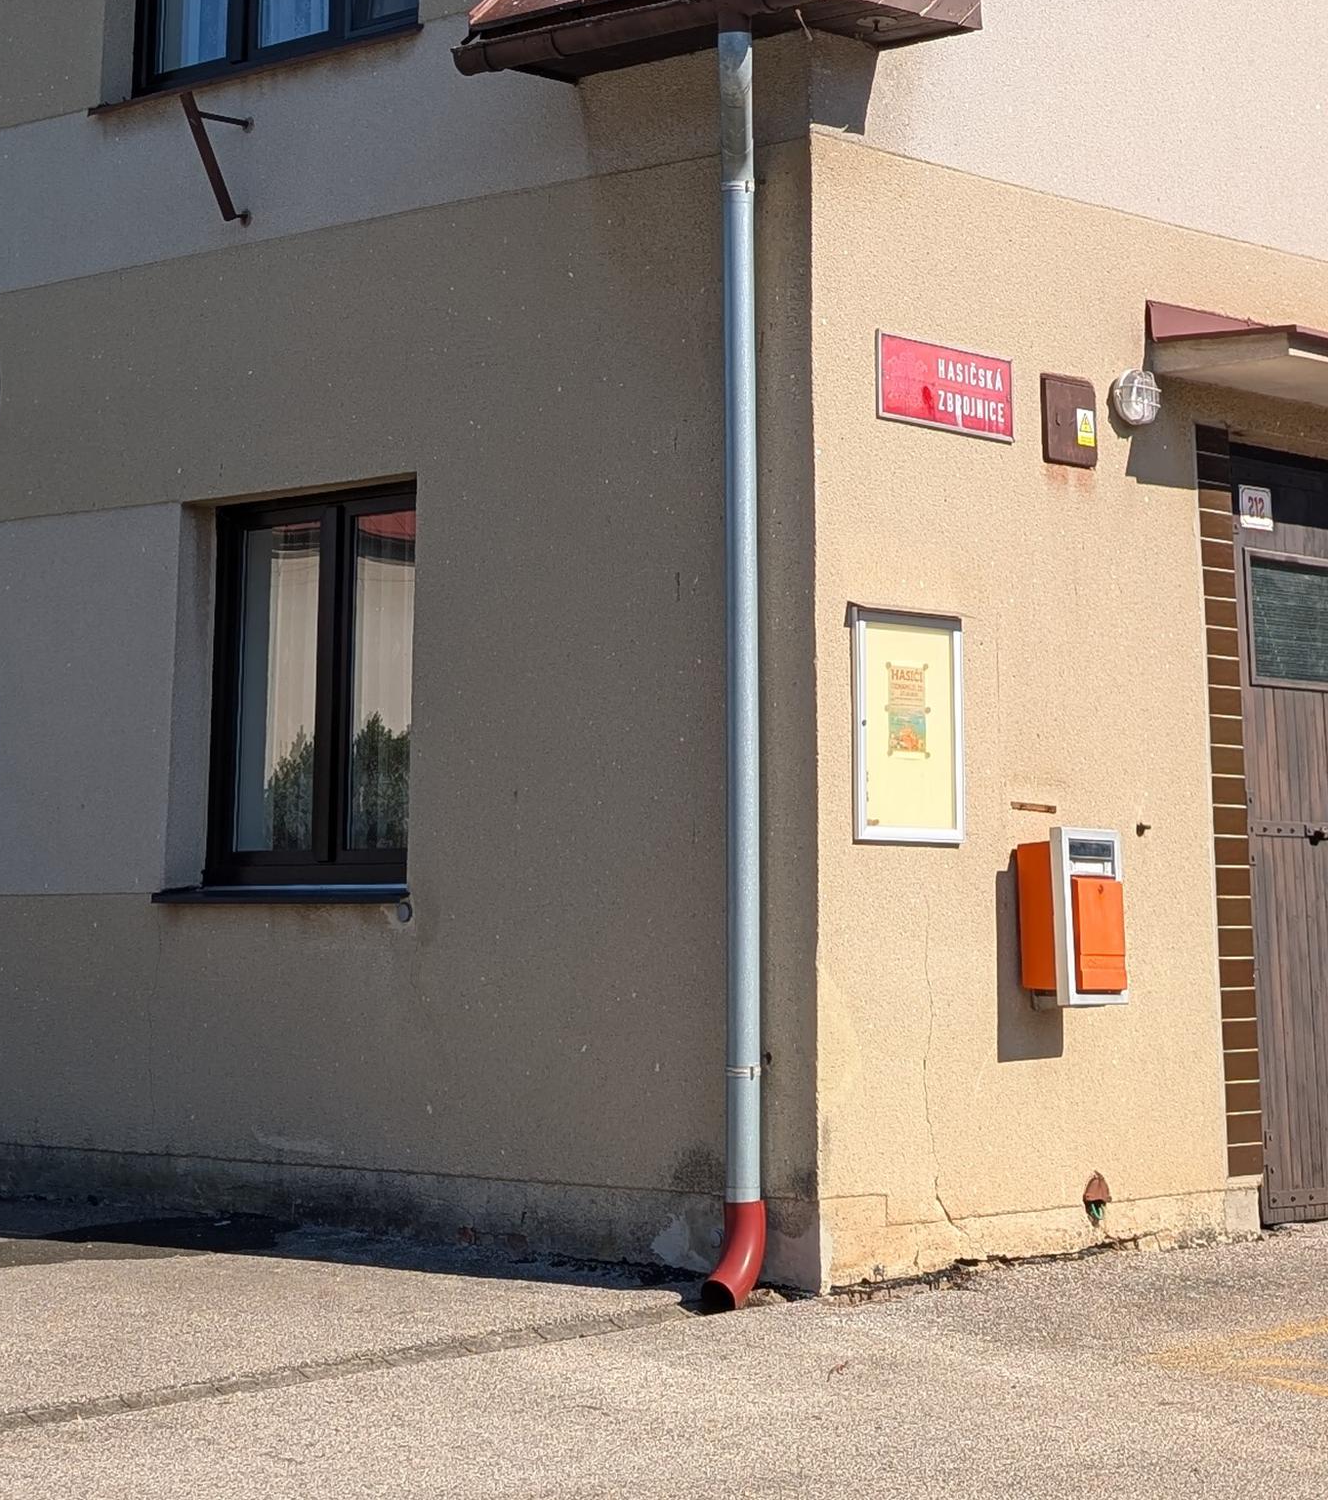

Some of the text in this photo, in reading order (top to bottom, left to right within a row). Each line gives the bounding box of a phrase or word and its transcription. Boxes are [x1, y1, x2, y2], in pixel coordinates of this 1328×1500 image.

[938, 358, 1003, 392] HASIČSKÁ
[938, 390, 1005, 424] ZBROJNICE
[1248, 496, 1265, 519] 212
